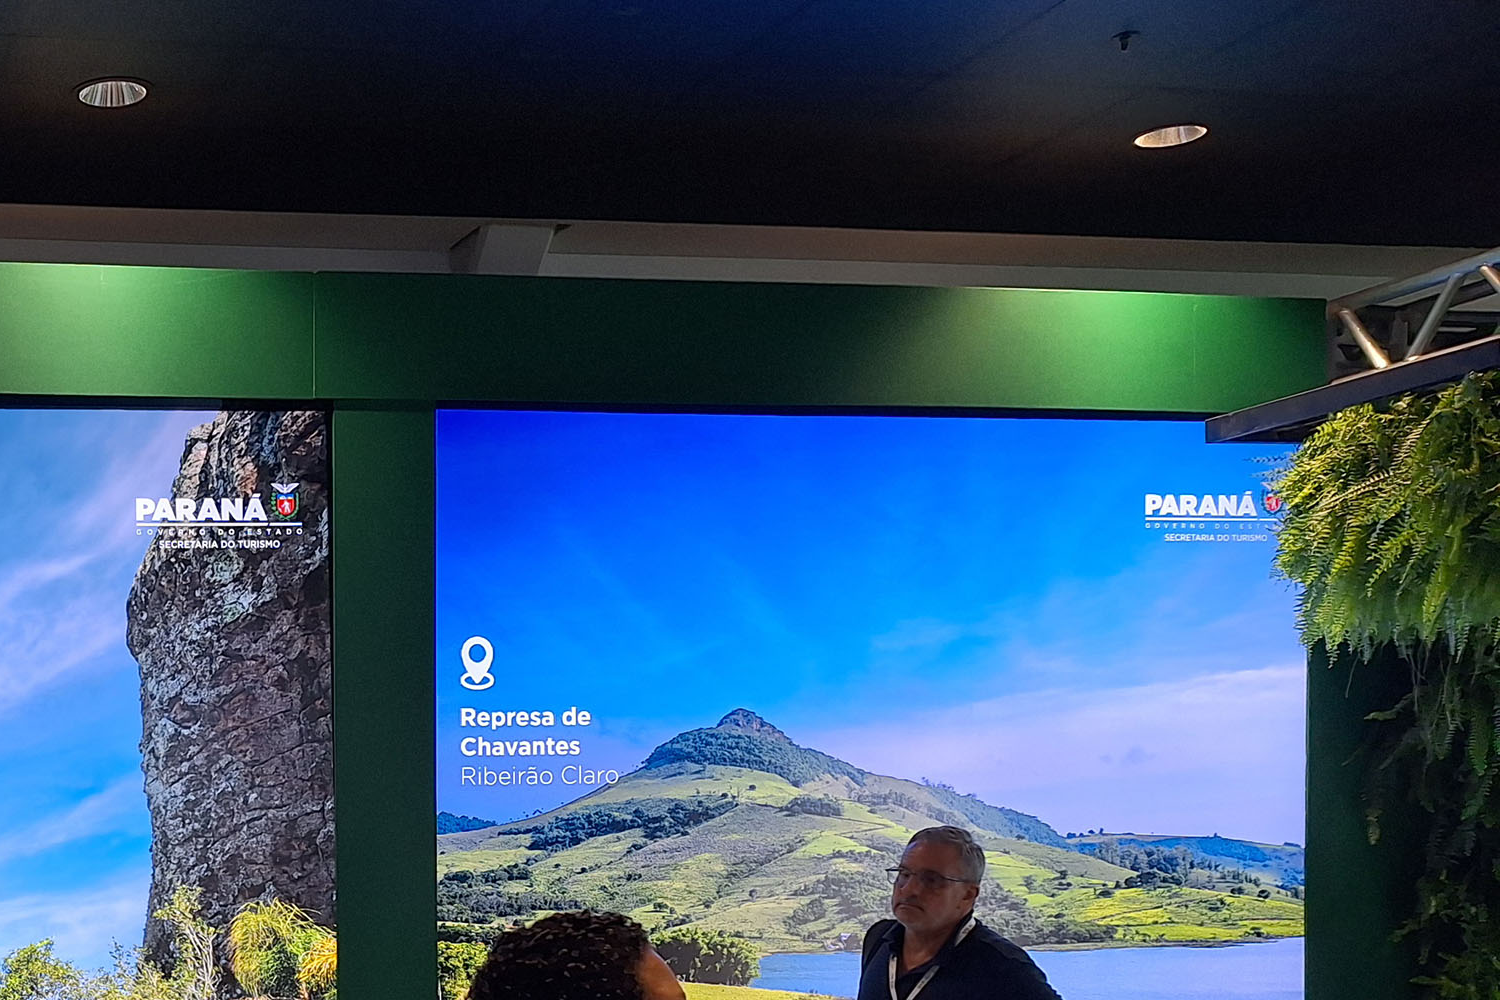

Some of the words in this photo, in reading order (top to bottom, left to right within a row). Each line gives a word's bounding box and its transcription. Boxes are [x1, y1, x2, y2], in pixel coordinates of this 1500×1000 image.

[135, 493, 268, 521] PARANÁ
[1145, 491, 1258, 516] PARANÁ
[136, 528, 206, 536] GOVERNO
[218, 528, 235, 536] DO
[247, 528, 303, 536] ESTADO
[1164, 533, 1215, 542] SECRETARIA
[1217, 534, 1230, 542] DO
[1232, 534, 1268, 542] TURISMO
[158, 540, 219, 549] SECRETARIA
[220, 540, 236, 549] DO
[238, 540, 281, 549] TURISMO
[460, 707, 555, 730] Represa
[562, 706, 591, 726] de
[460, 737, 581, 756] Chavantes
[461, 766, 553, 785] Ribeirão
[561, 765, 619, 784] Claro
